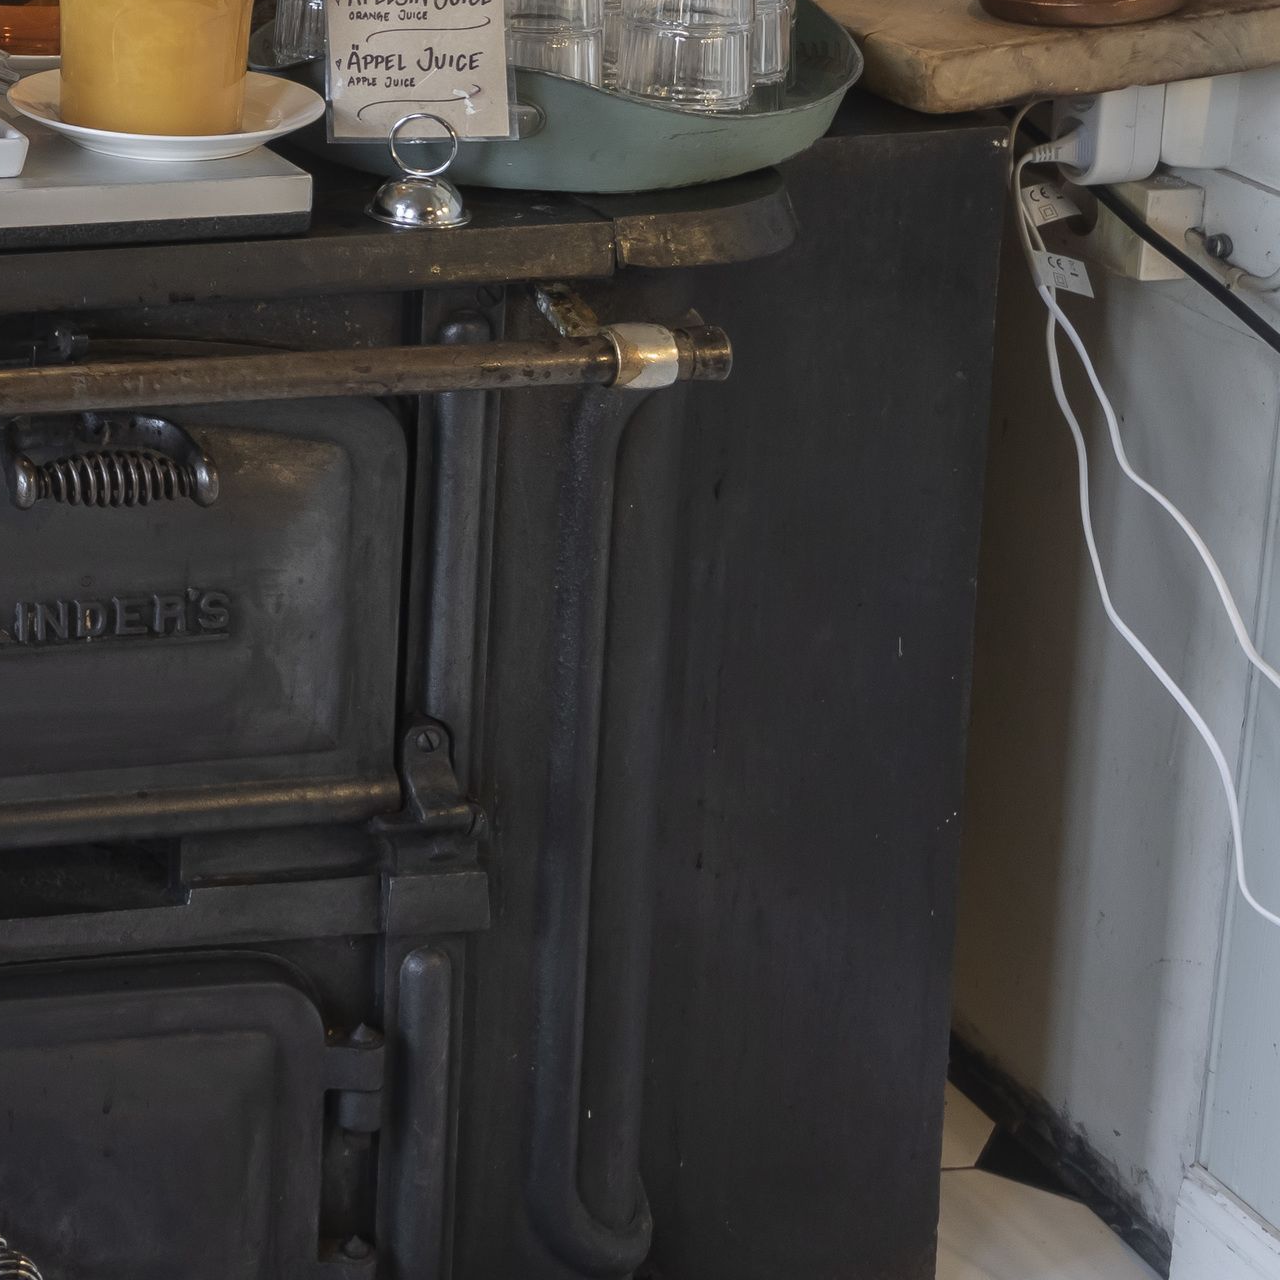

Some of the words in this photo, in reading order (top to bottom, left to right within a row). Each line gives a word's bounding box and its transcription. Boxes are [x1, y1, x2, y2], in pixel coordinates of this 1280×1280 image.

[348, 11, 390, 22] ORANGE
[397, 9, 428, 21] JUICE
[347, 44, 407, 73] ÄPPEL
[416, 47, 484, 72] JUICE
[347, 76, 377, 88] APPLE
[384, 75, 416, 88] JUICE
